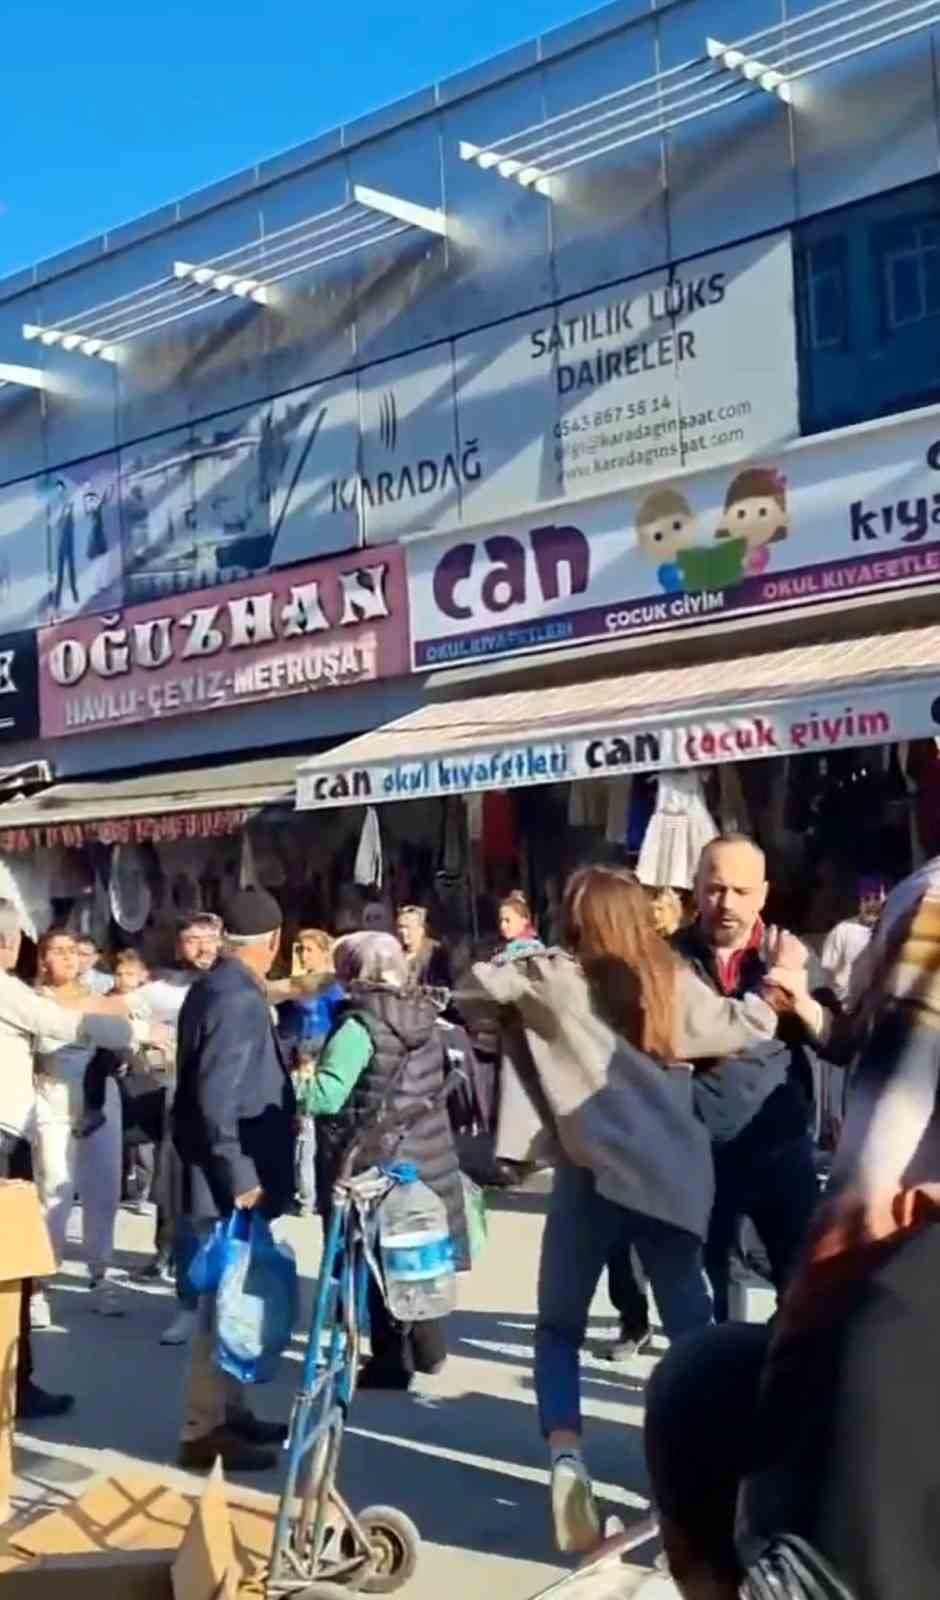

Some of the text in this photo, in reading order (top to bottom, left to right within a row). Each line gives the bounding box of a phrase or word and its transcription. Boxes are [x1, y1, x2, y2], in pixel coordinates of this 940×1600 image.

[531, 273, 725, 359] SATILIK LÜKS
[557, 331, 696, 394] DAİRELER
[331, 438, 481, 513] KARADAĞ
[433, 525, 590, 620] can
[604, 591, 724, 634] ÇOCUK GİYİM
[763, 577, 818, 599] OKUL
[49, 564, 389, 684] OĞUZHAN
[313, 768, 371, 800] can
[585, 732, 660, 769] can
[790, 707, 889, 748] giyim
